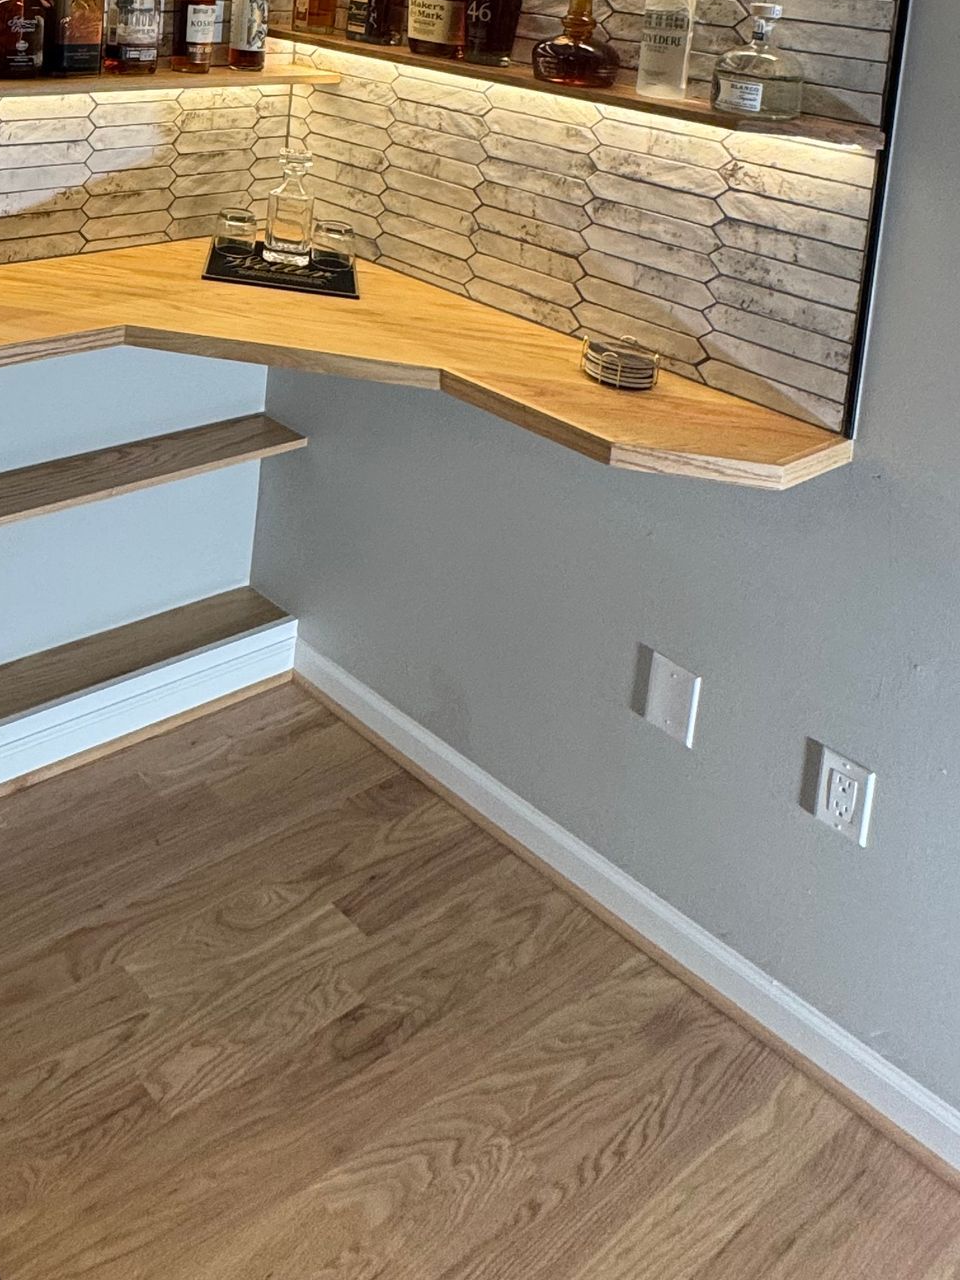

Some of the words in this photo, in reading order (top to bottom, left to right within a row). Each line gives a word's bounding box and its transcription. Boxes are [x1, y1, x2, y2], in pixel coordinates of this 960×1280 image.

[411, 0, 445, 11] Maker's
[467, 1, 492, 22] 46
[417, 9, 443, 21] Mark
